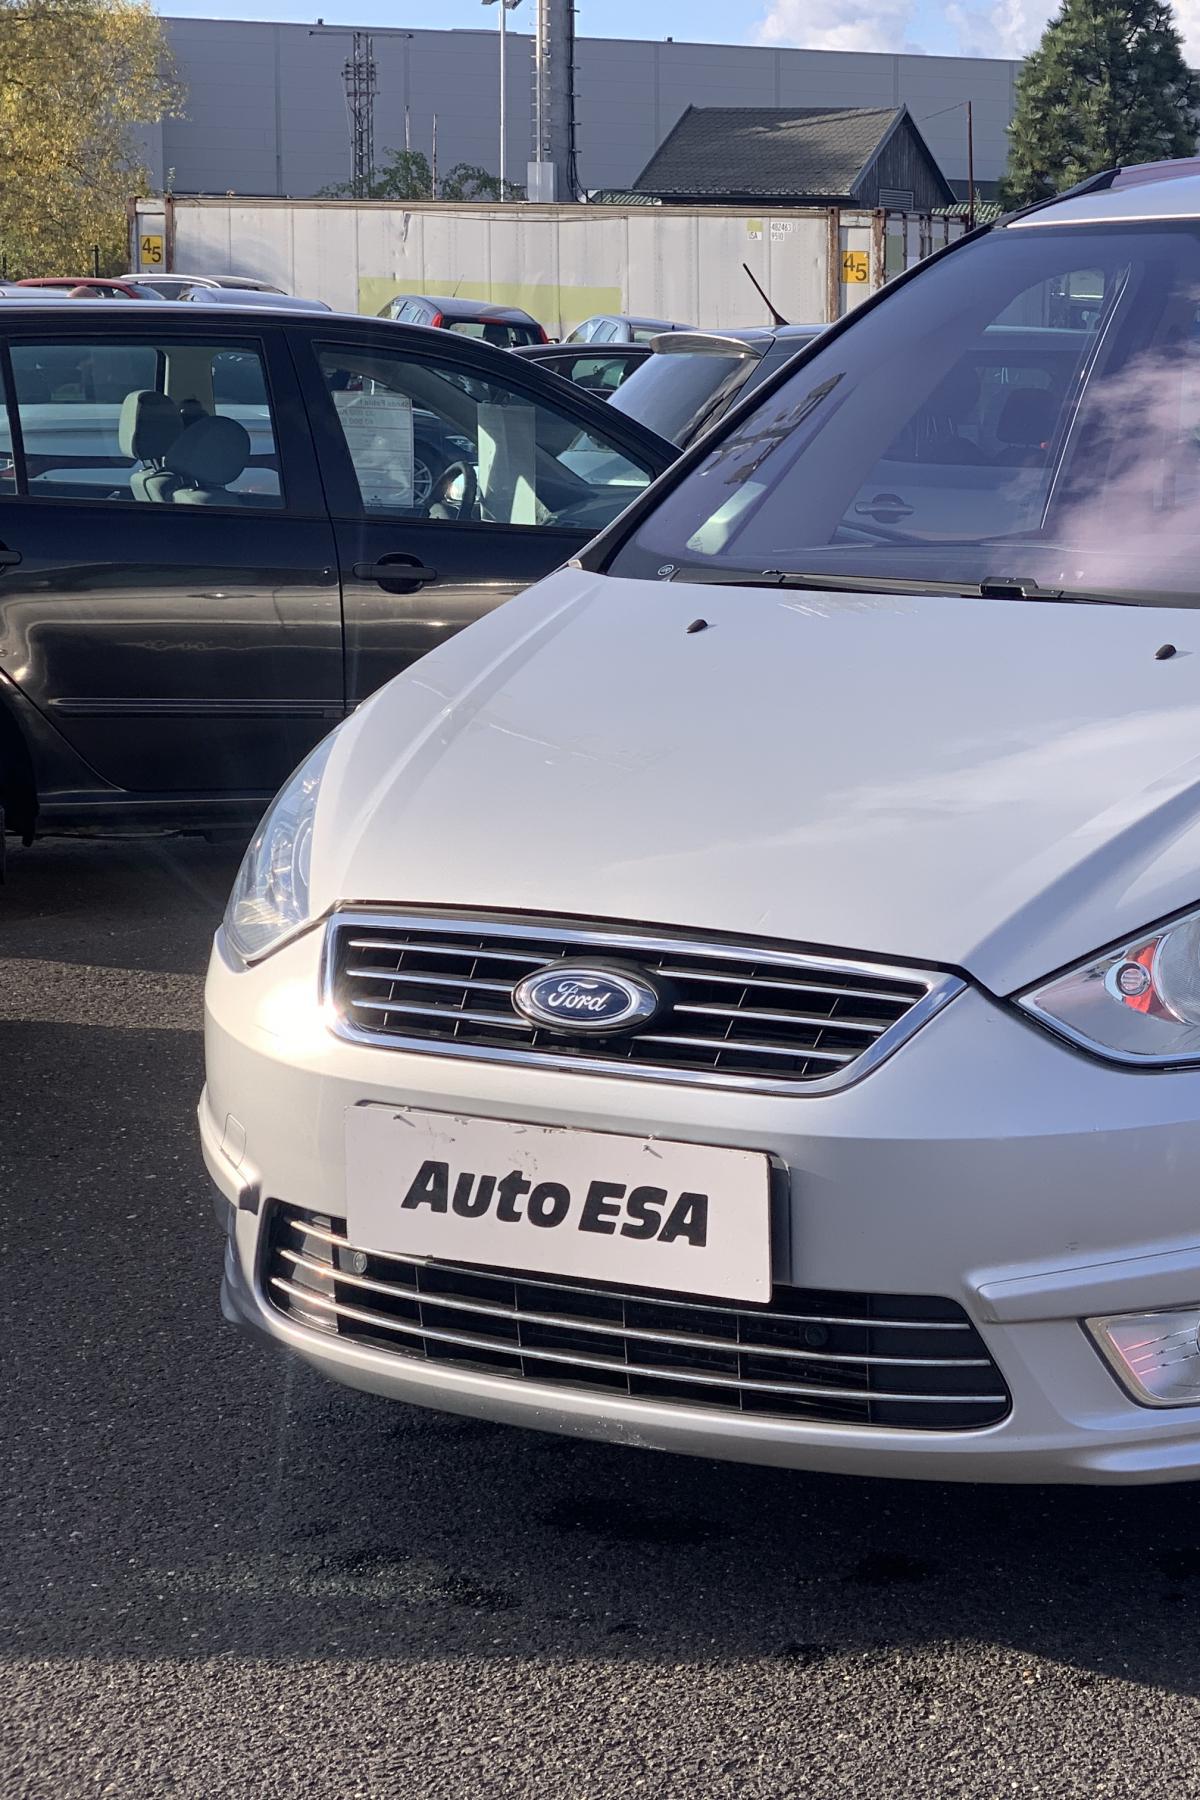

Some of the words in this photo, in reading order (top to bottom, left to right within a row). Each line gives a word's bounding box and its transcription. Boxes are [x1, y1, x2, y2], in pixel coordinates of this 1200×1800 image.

[142, 237, 162, 263] 45
[842, 253, 867, 281] 45
[548, 980, 612, 1011] Ford
[400, 1160, 571, 1228] Auto
[578, 1180, 709, 1248] ESA
